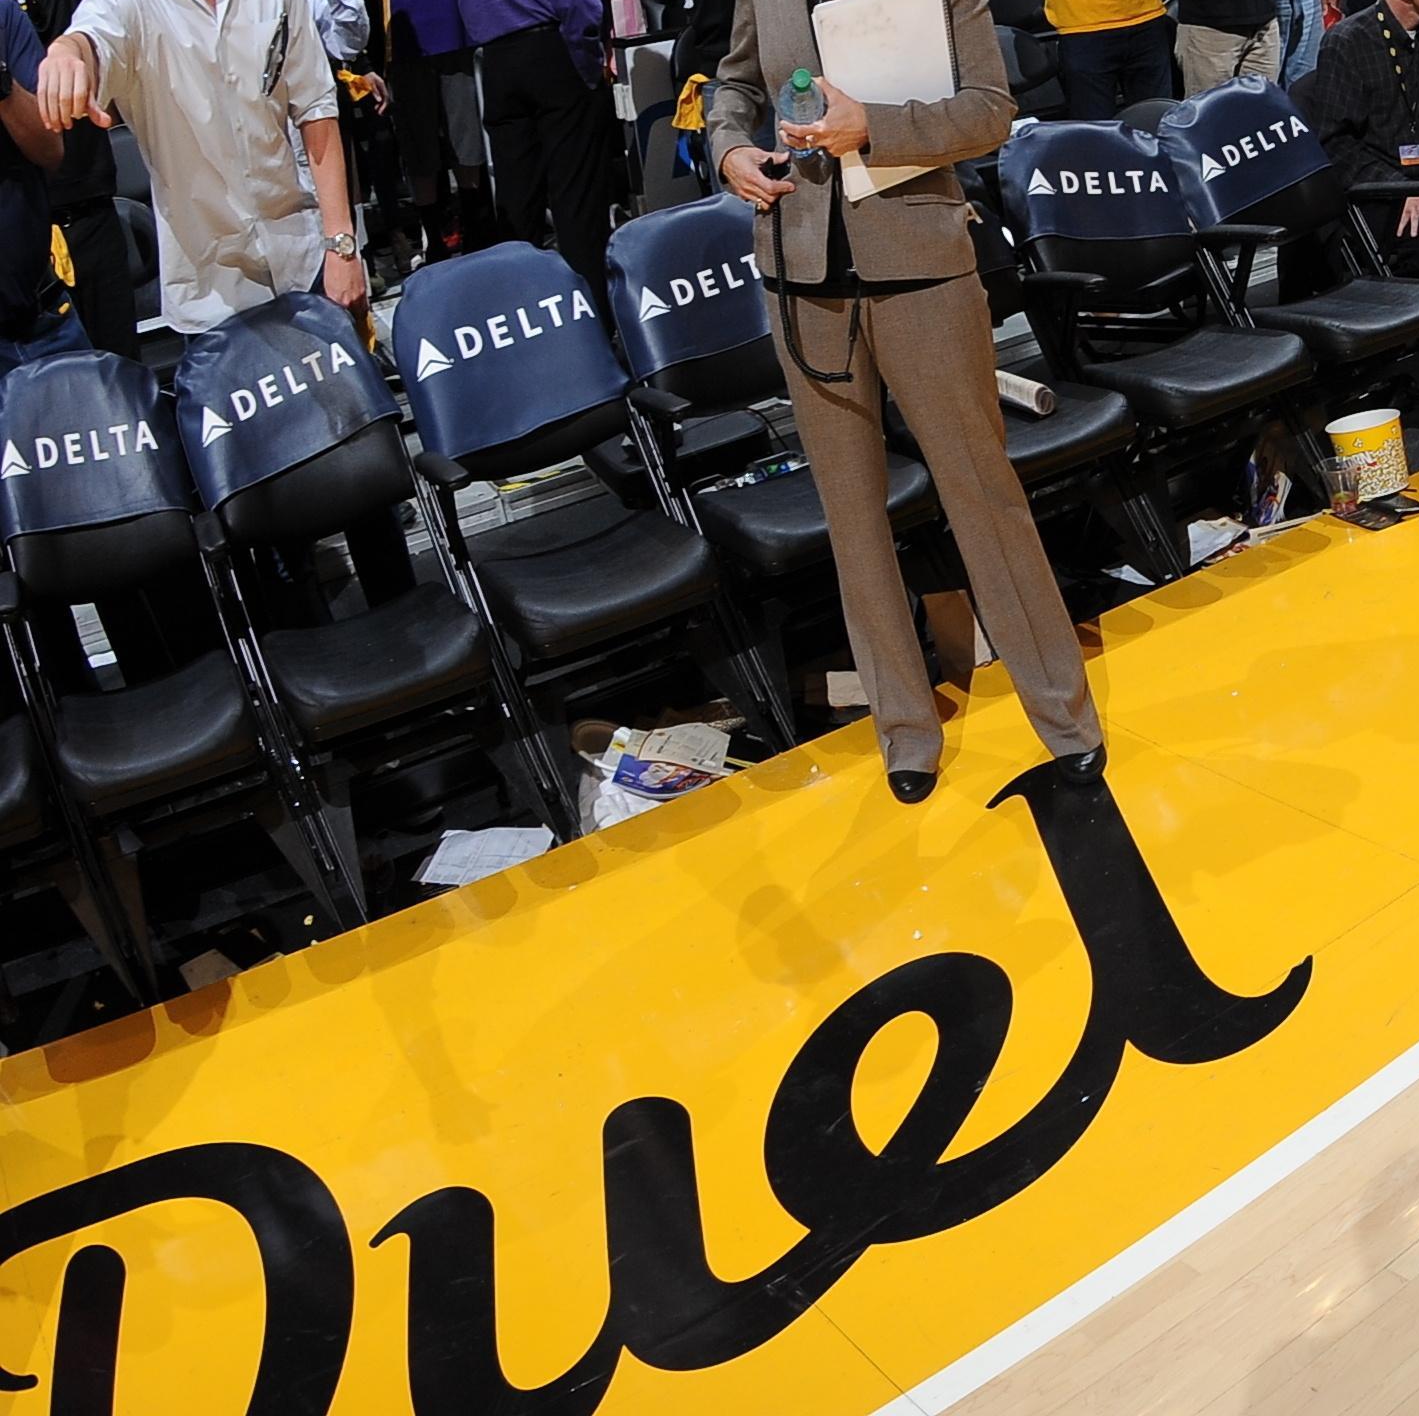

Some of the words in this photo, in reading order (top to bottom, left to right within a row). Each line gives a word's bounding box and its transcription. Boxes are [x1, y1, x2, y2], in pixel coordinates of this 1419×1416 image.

[1221, 114, 1310, 167] DELTA
[1059, 170, 1169, 194] DELTA
[669, 252, 762, 306] DELT
[454, 289, 596, 359] DELTA
[230, 341, 356, 422] DELTA
[34, 421, 159, 469] DELTA
